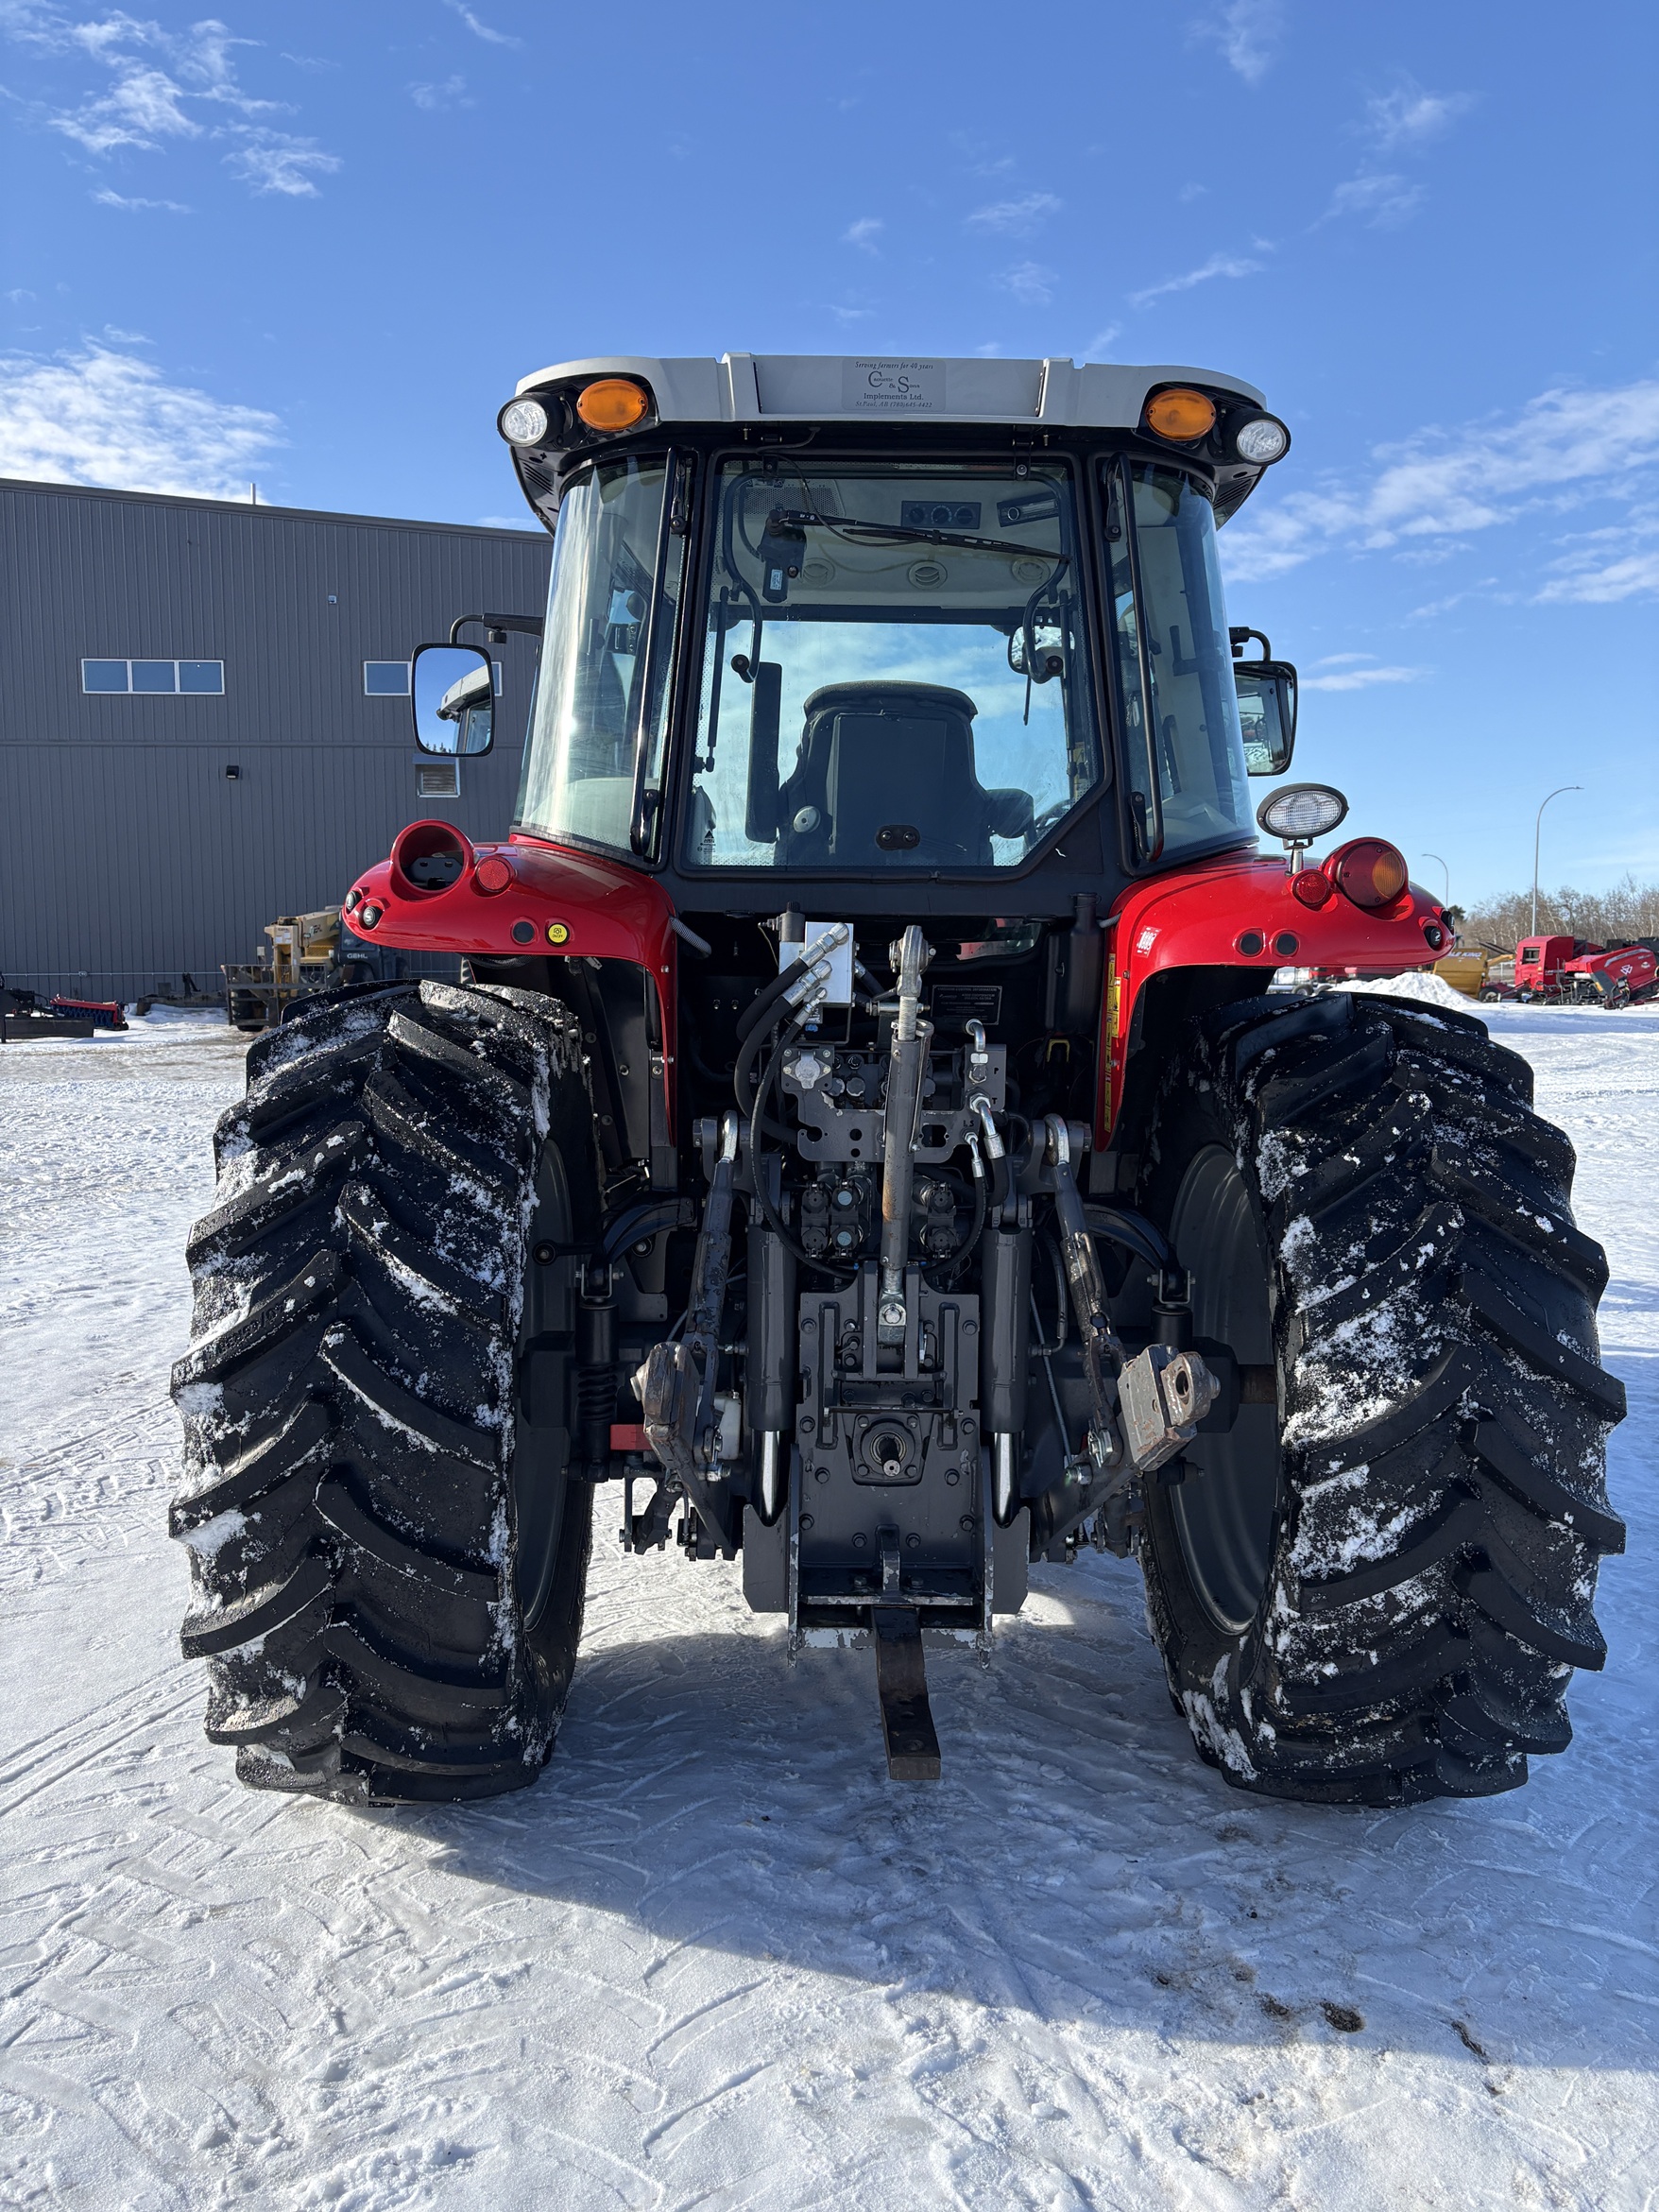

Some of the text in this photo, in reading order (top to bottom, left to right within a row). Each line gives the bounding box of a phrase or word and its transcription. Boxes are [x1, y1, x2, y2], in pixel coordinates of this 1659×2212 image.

[855, 361, 877, 369] Serving
[898, 362, 909, 370] for
[917, 363, 933, 371] years
[864, 392, 907, 401] Implements
